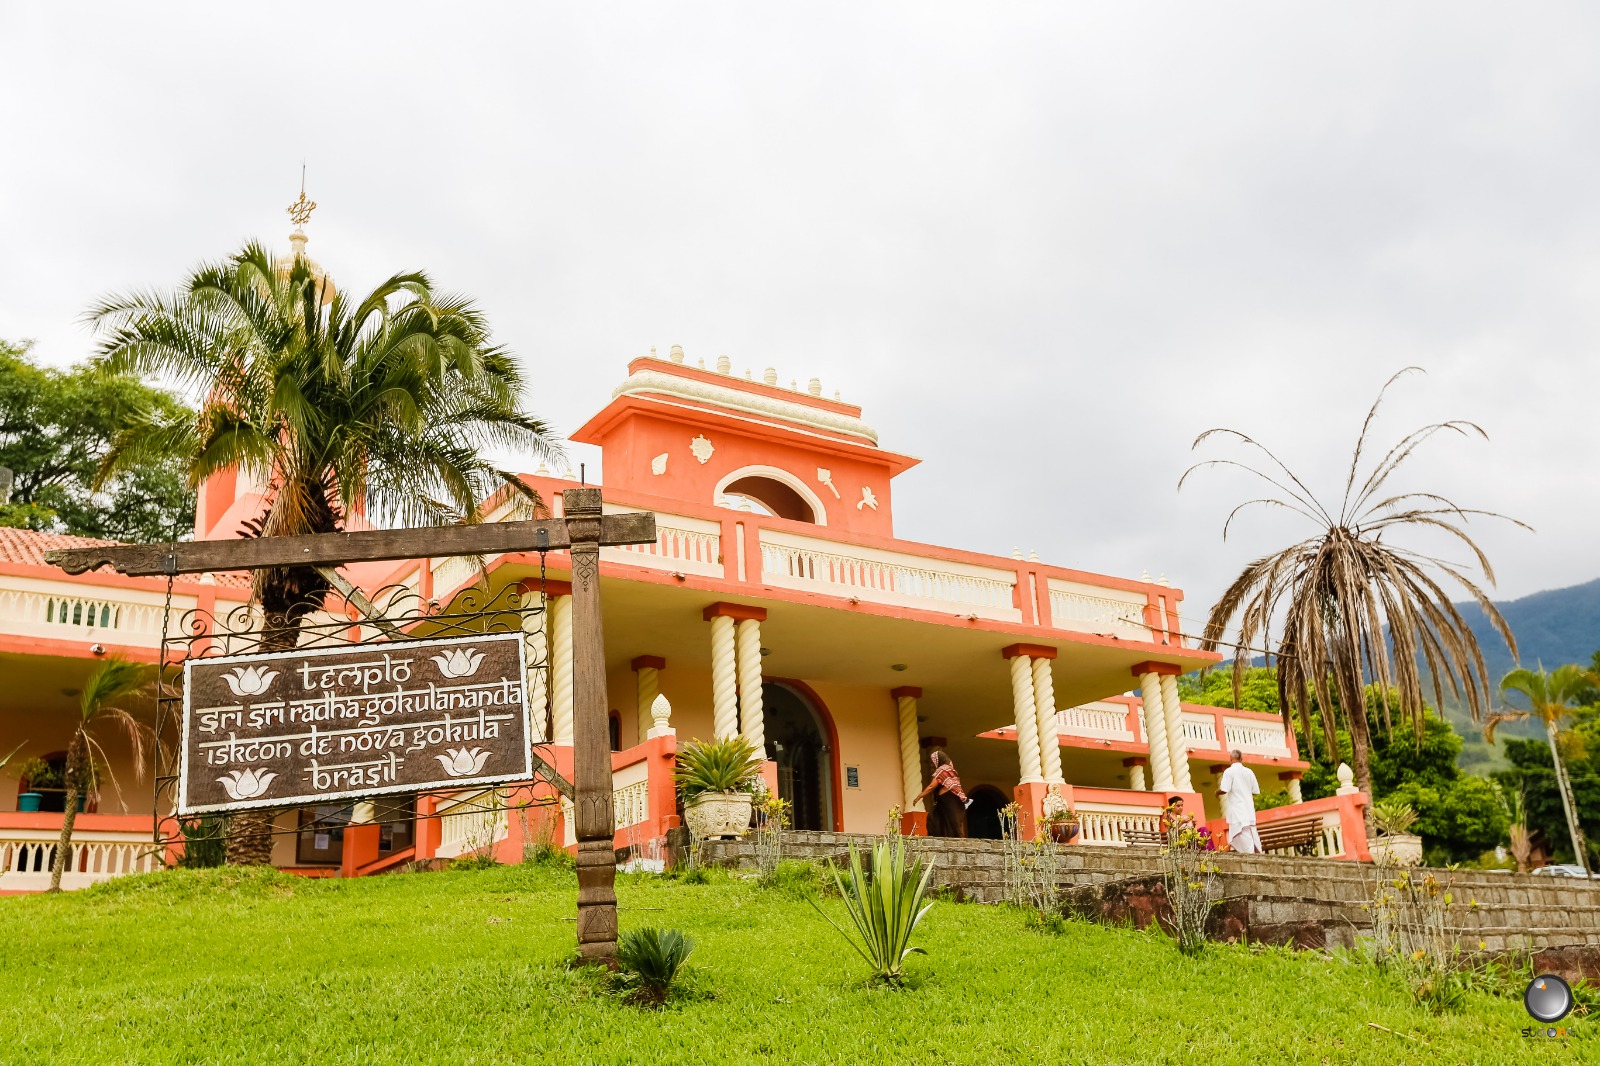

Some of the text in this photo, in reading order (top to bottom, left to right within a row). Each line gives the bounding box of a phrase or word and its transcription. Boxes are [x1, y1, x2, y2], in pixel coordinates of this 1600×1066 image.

[297, 654, 413, 694] templo
[196, 701, 243, 734] sri
[247, 697, 286, 729] sri
[300, 725, 332, 756] de
[340, 727, 405, 752] nova
